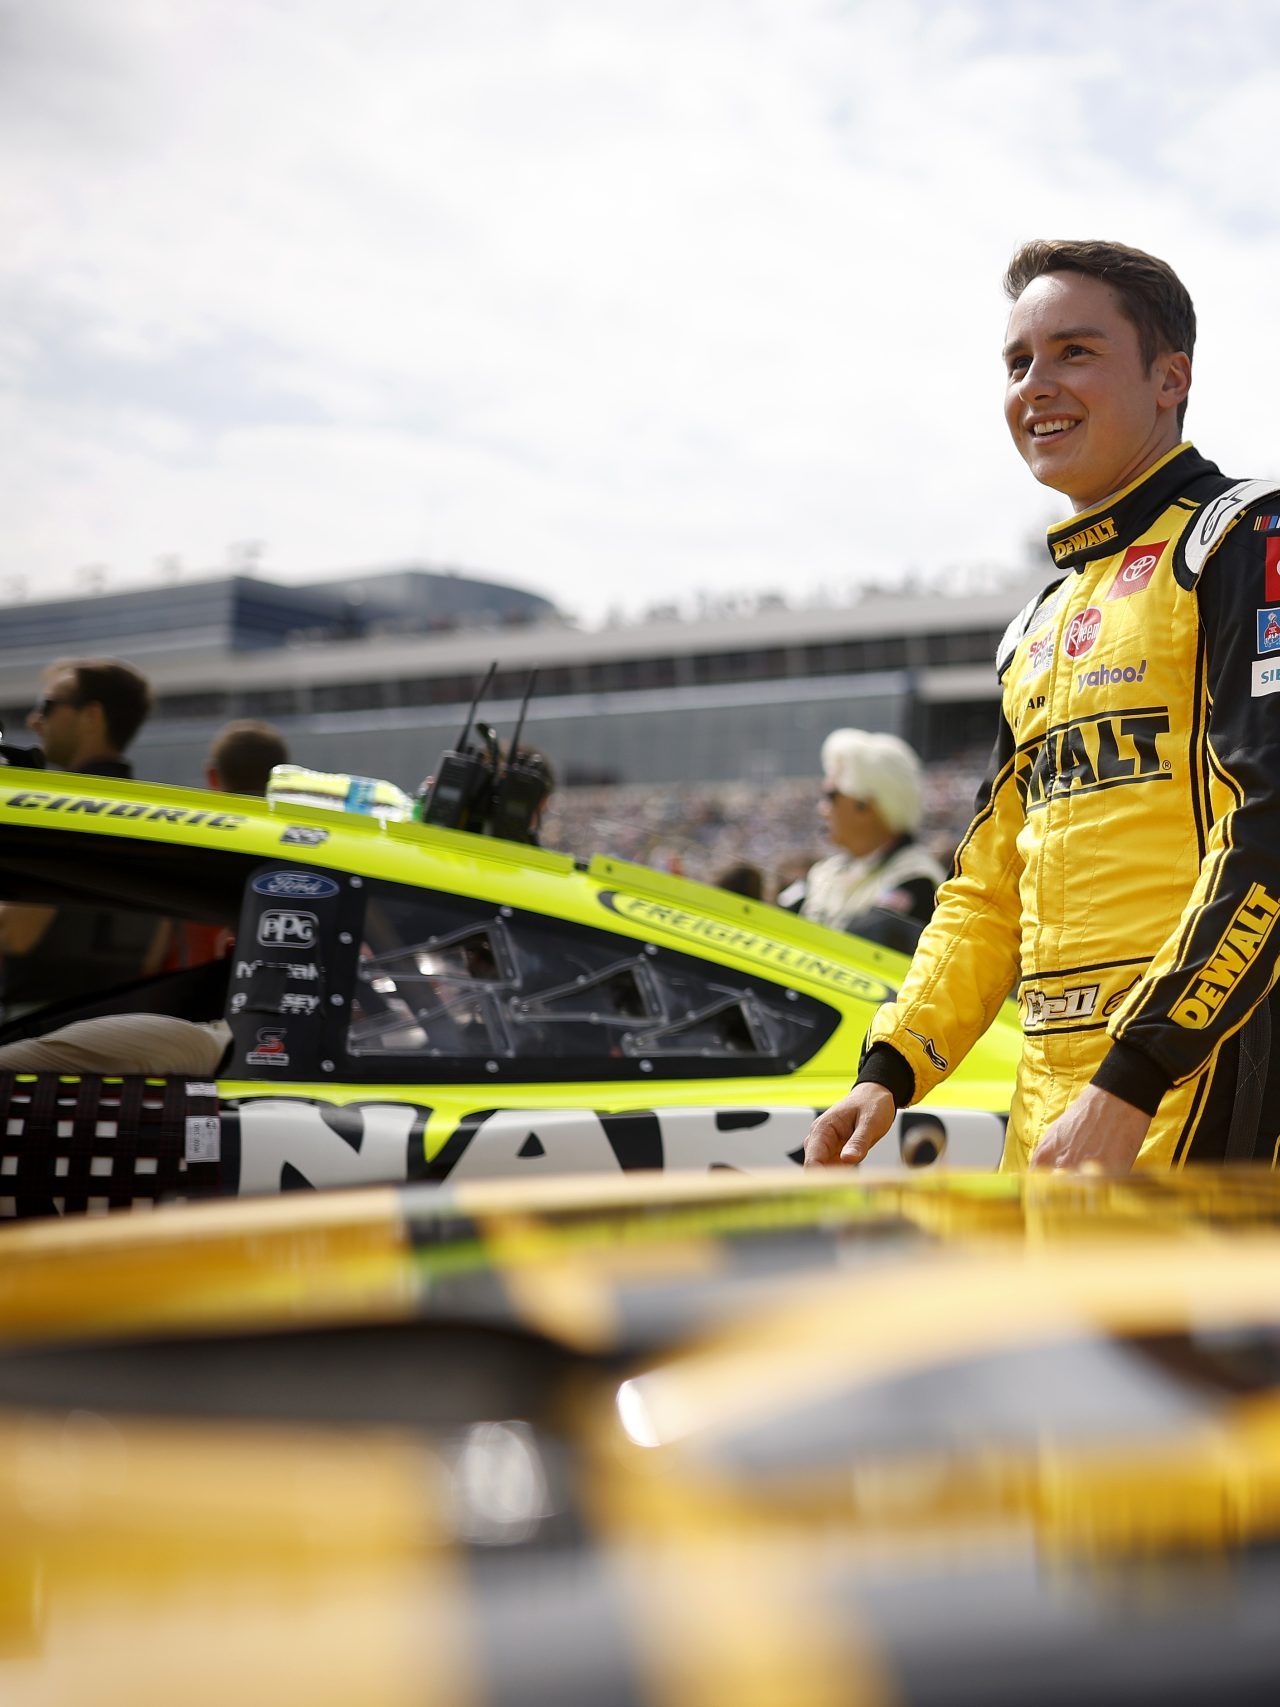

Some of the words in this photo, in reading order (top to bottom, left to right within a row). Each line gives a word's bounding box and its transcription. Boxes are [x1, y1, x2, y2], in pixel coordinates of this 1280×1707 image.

[1067, 619, 1101, 651] Rheem
[1078, 661, 1147, 695] yahoo!
[6, 792, 247, 828] CINDRIC
[267, 872, 323, 893] Ford
[263, 916, 313, 942] PPG
[626, 899, 873, 992] FREIGHTLINER
[1171, 884, 1280, 1030] DEWALT
